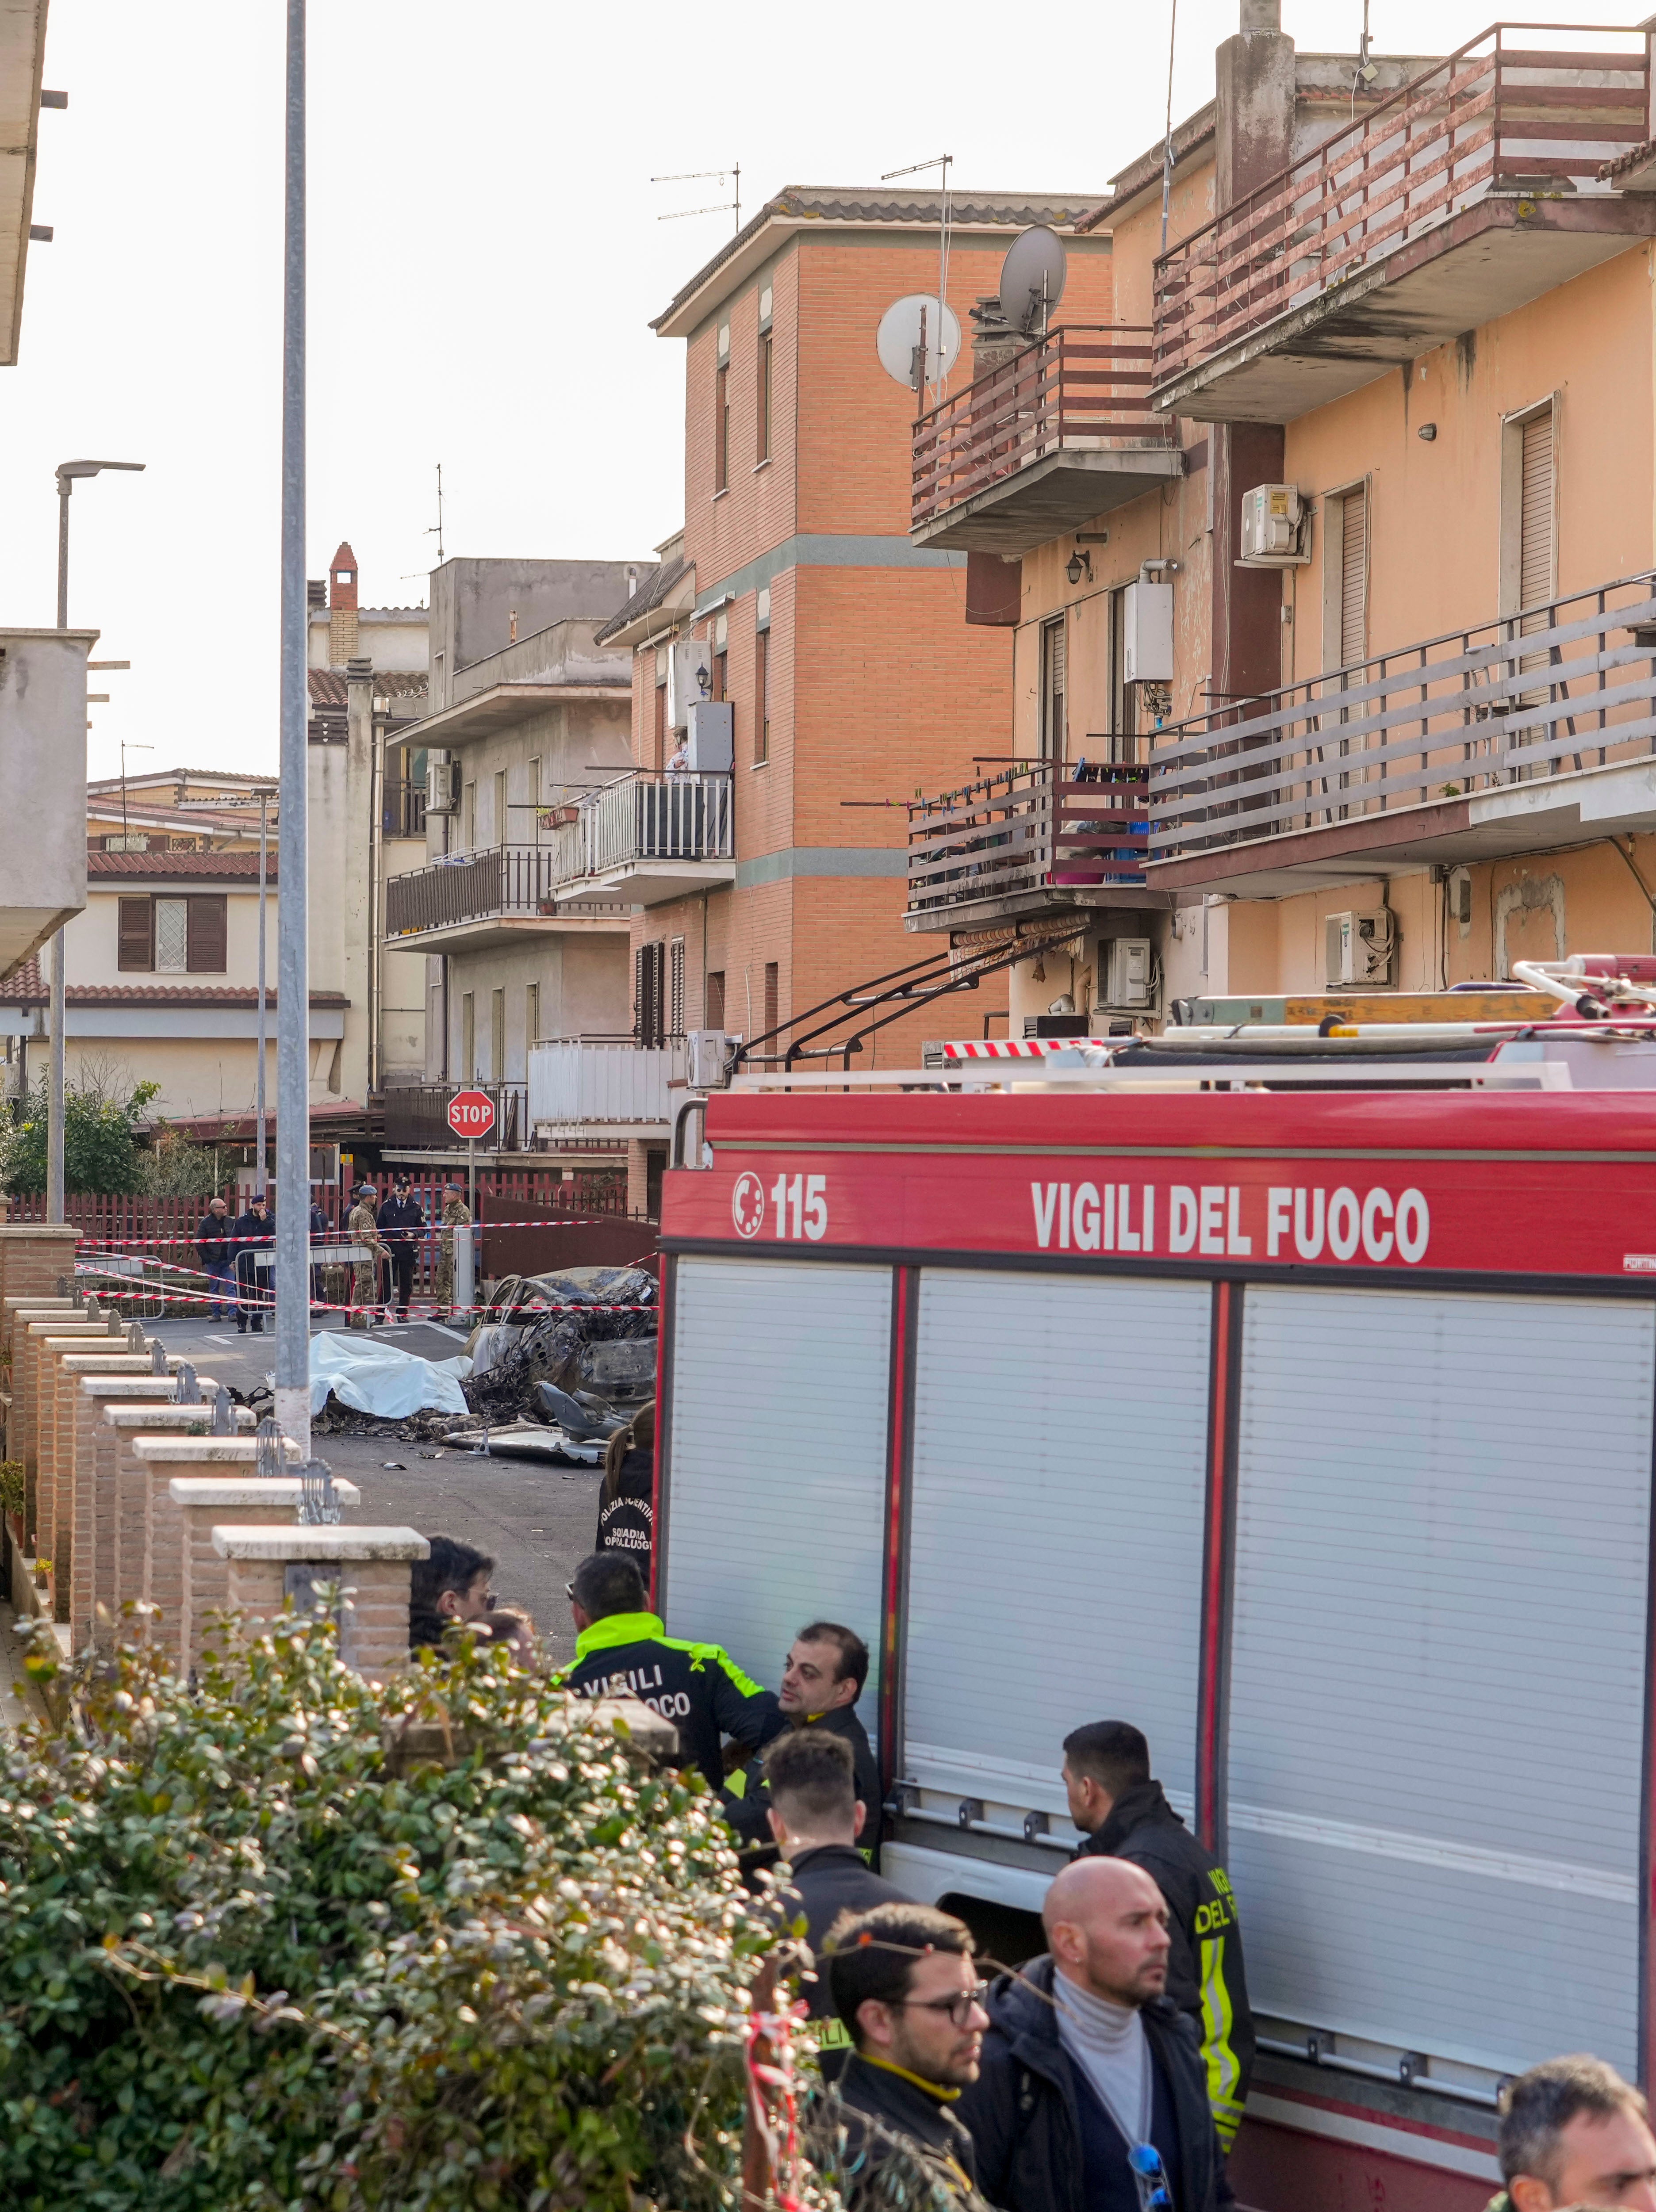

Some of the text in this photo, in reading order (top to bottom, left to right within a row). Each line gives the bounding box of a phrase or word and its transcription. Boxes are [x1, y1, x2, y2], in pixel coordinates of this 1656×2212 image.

[451, 1105, 491, 1123] STOP
[770, 1173, 828, 1241] 115
[1031, 1181, 1430, 1264] VIGILI DEL FUOCO
[583, 1664, 663, 1699] VIGILI
[644, 1692, 690, 1718] OCO
[1195, 1899, 1230, 1935] DEL
